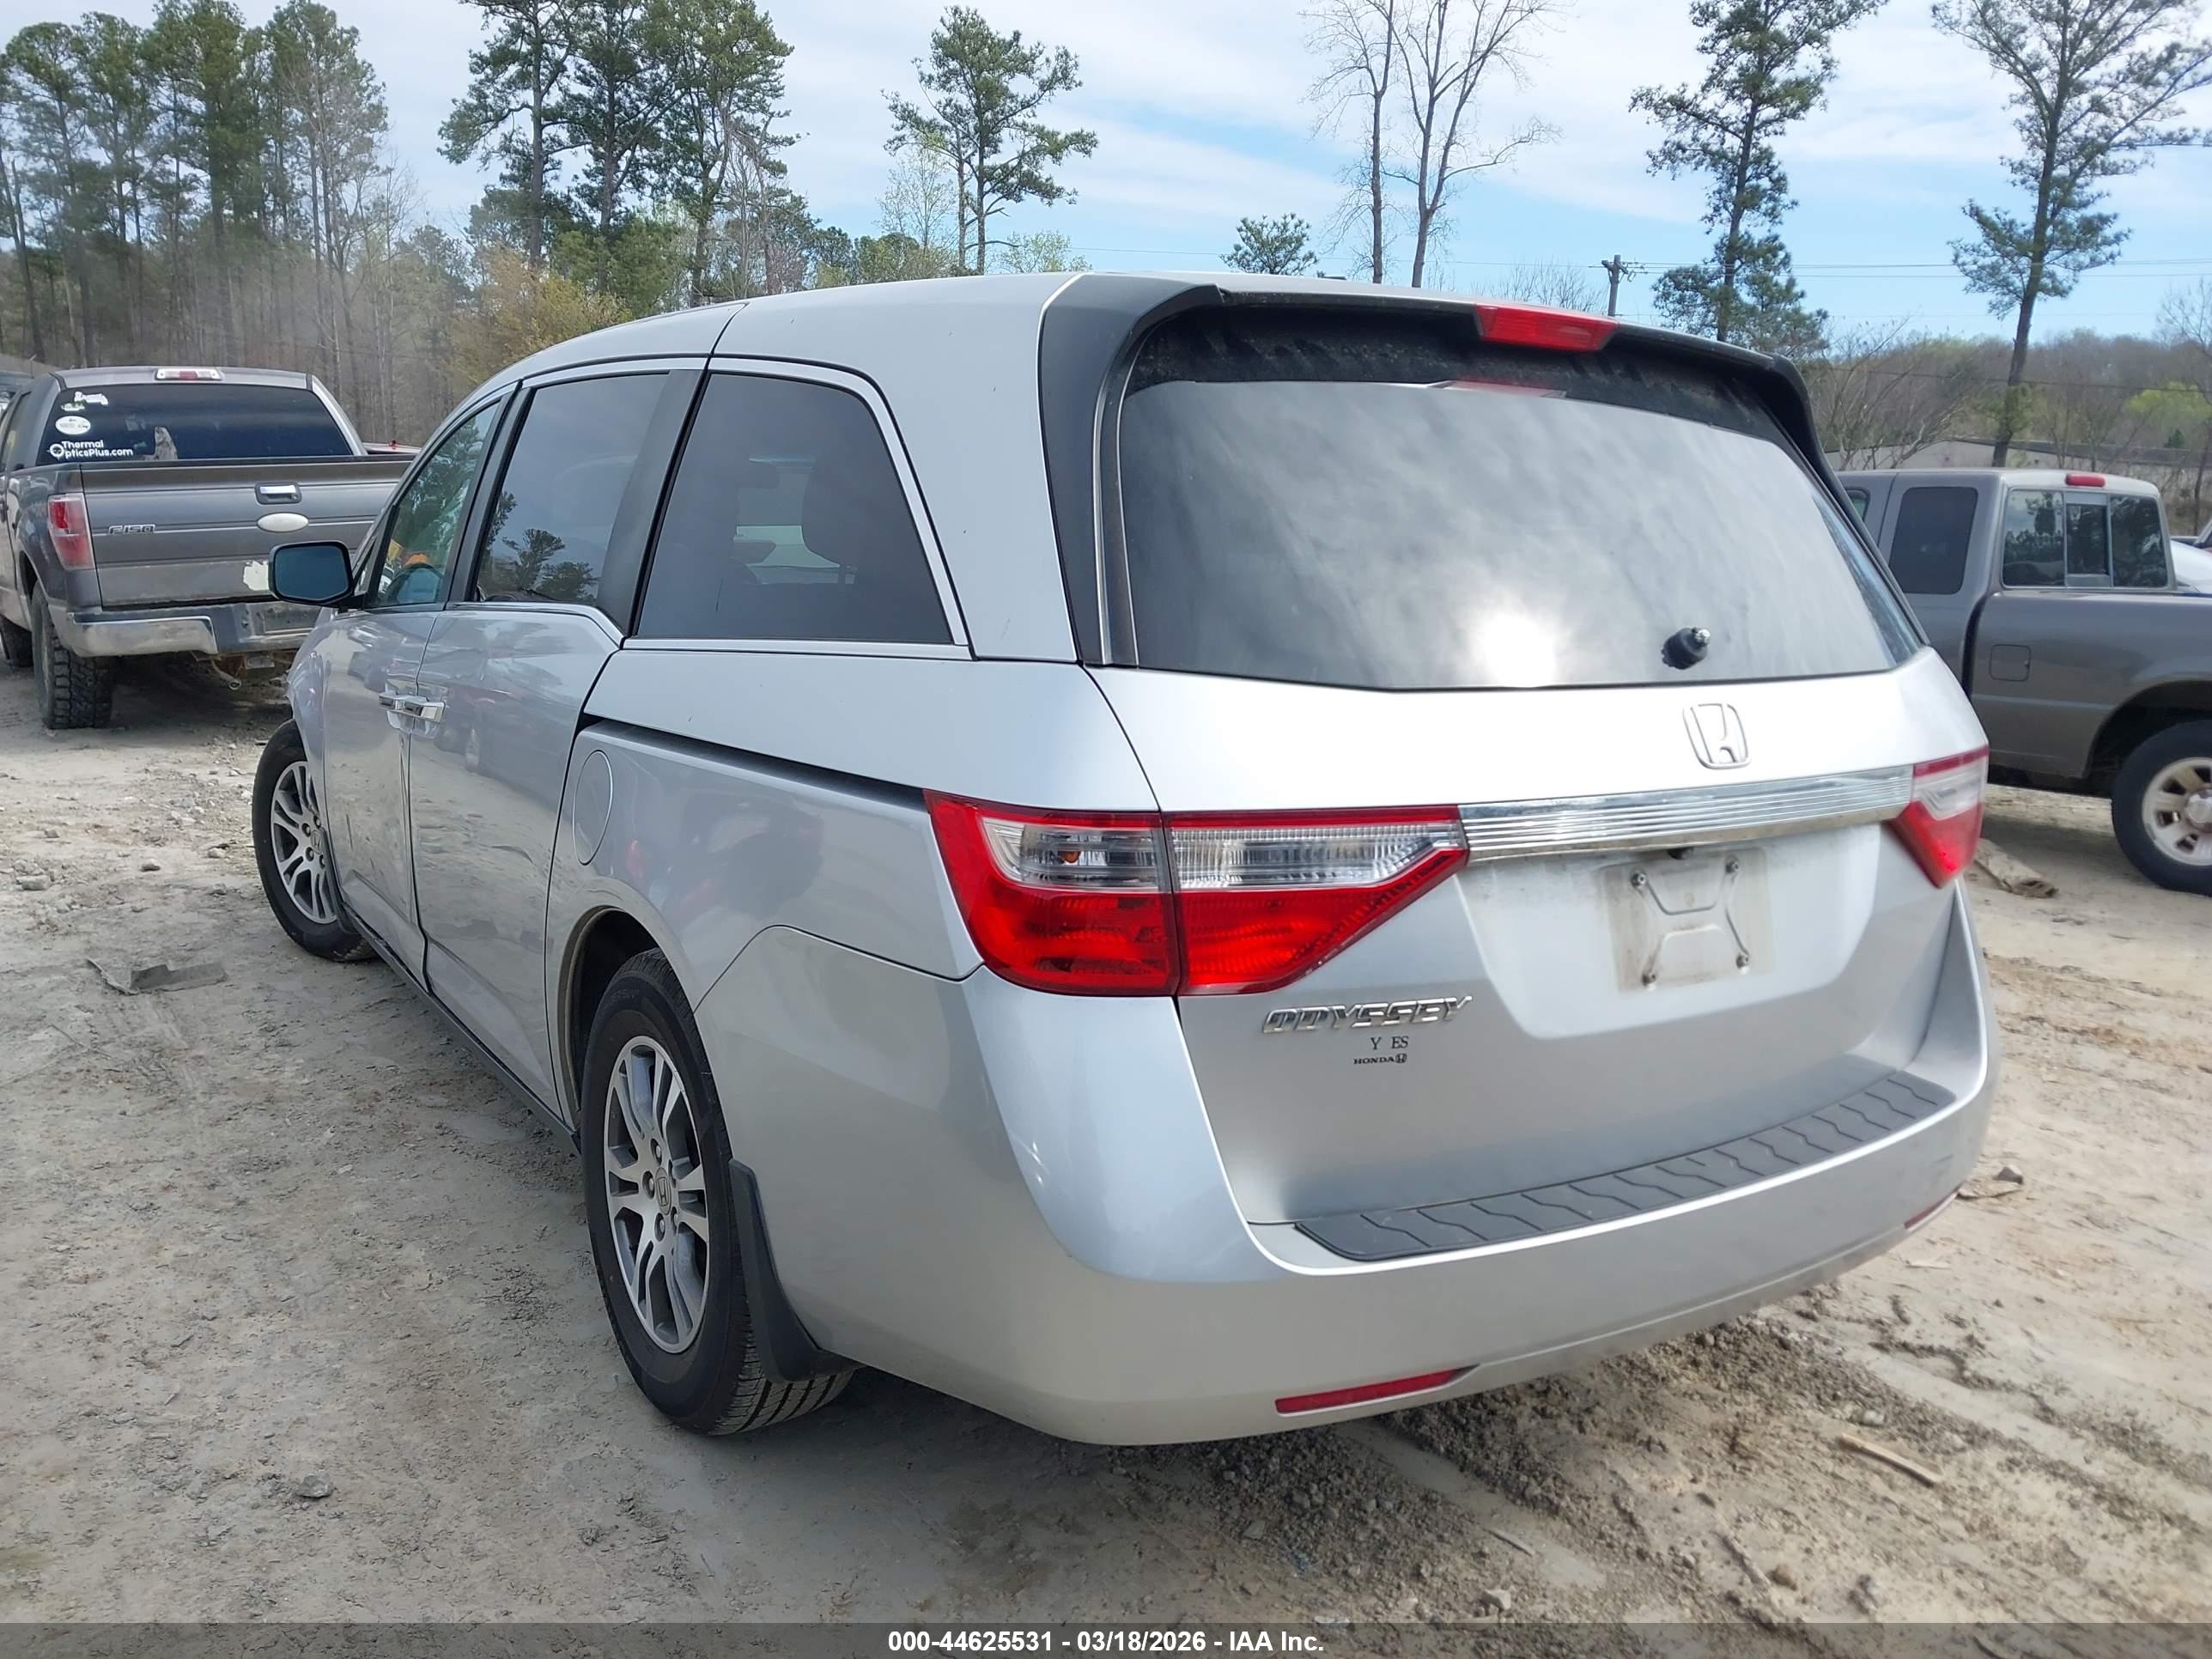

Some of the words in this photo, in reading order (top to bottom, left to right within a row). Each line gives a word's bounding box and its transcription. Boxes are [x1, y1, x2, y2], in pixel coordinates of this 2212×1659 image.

[61, 439, 104, 448] Thermal
[1263, 995, 1473, 1033] ODYSSEY
[1353, 1056, 1395, 1065] HONDA
